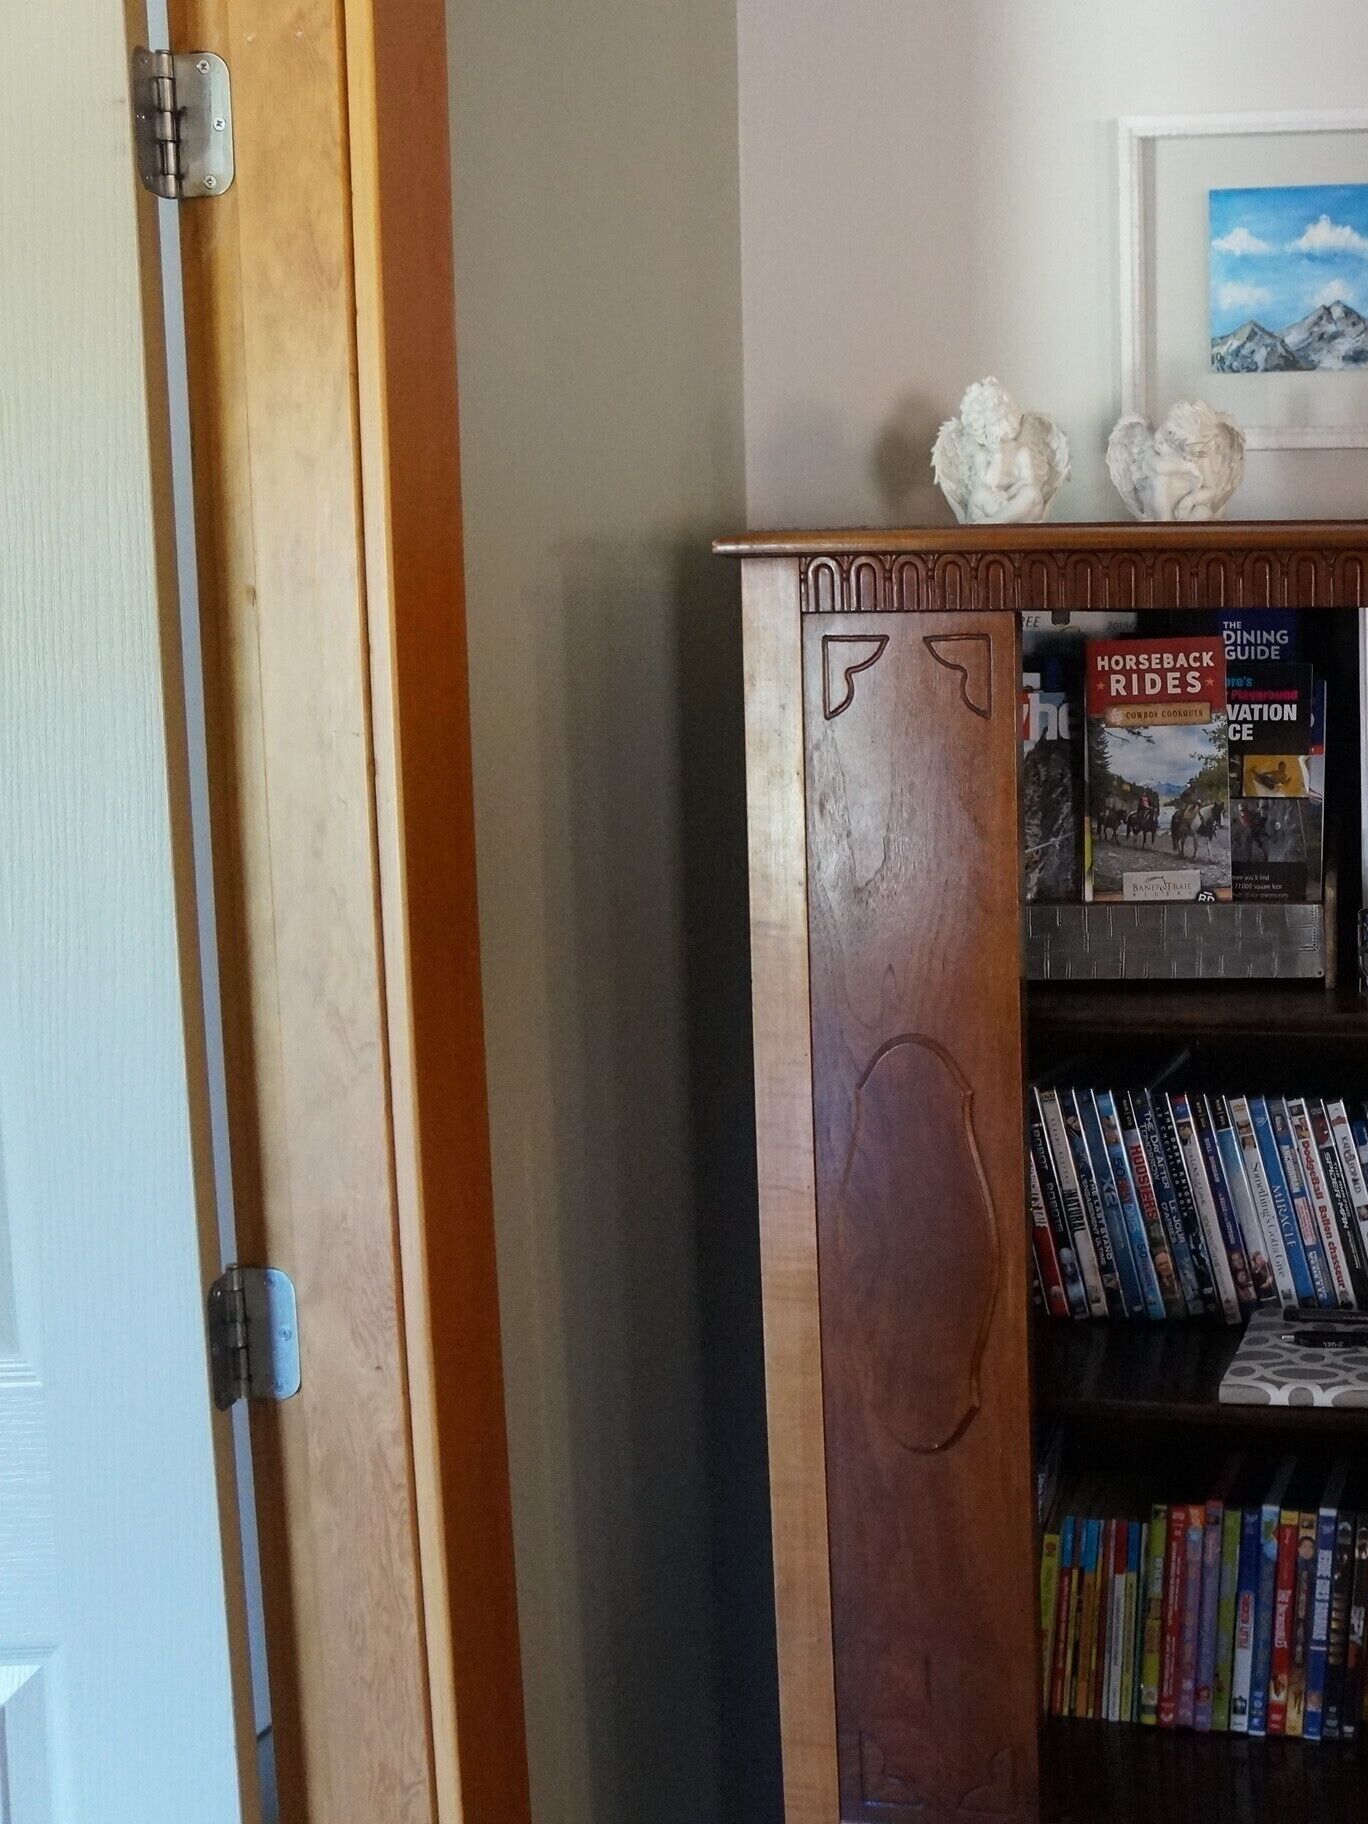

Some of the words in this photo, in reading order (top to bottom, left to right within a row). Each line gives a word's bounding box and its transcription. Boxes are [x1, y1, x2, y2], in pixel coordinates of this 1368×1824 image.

[1222, 621, 1242, 629] THE
[1222, 630, 1289, 645] DINING
[1096, 651, 1215, 671] HORSEBACK
[1224, 645, 1281, 661] GUIDE
[1110, 671, 1202, 696] RIDES
[1125, 711, 1159, 720] COWBOY
[1161, 709, 1203, 718] COOKOUTS
[1228, 723, 1254, 741] CE
[1149, 1133, 1161, 1154] DAY
[1169, 1133, 1182, 1164] DARK
[1131, 1143, 1159, 1222] HOOSIERS
[1324, 1150, 1348, 1230] SPIDER-MAN
[1272, 1183, 1295, 1248] MIRACLE
[1317, 1204, 1334, 1239] Ballon
[1327, 1239, 1345, 1288] chasseur
